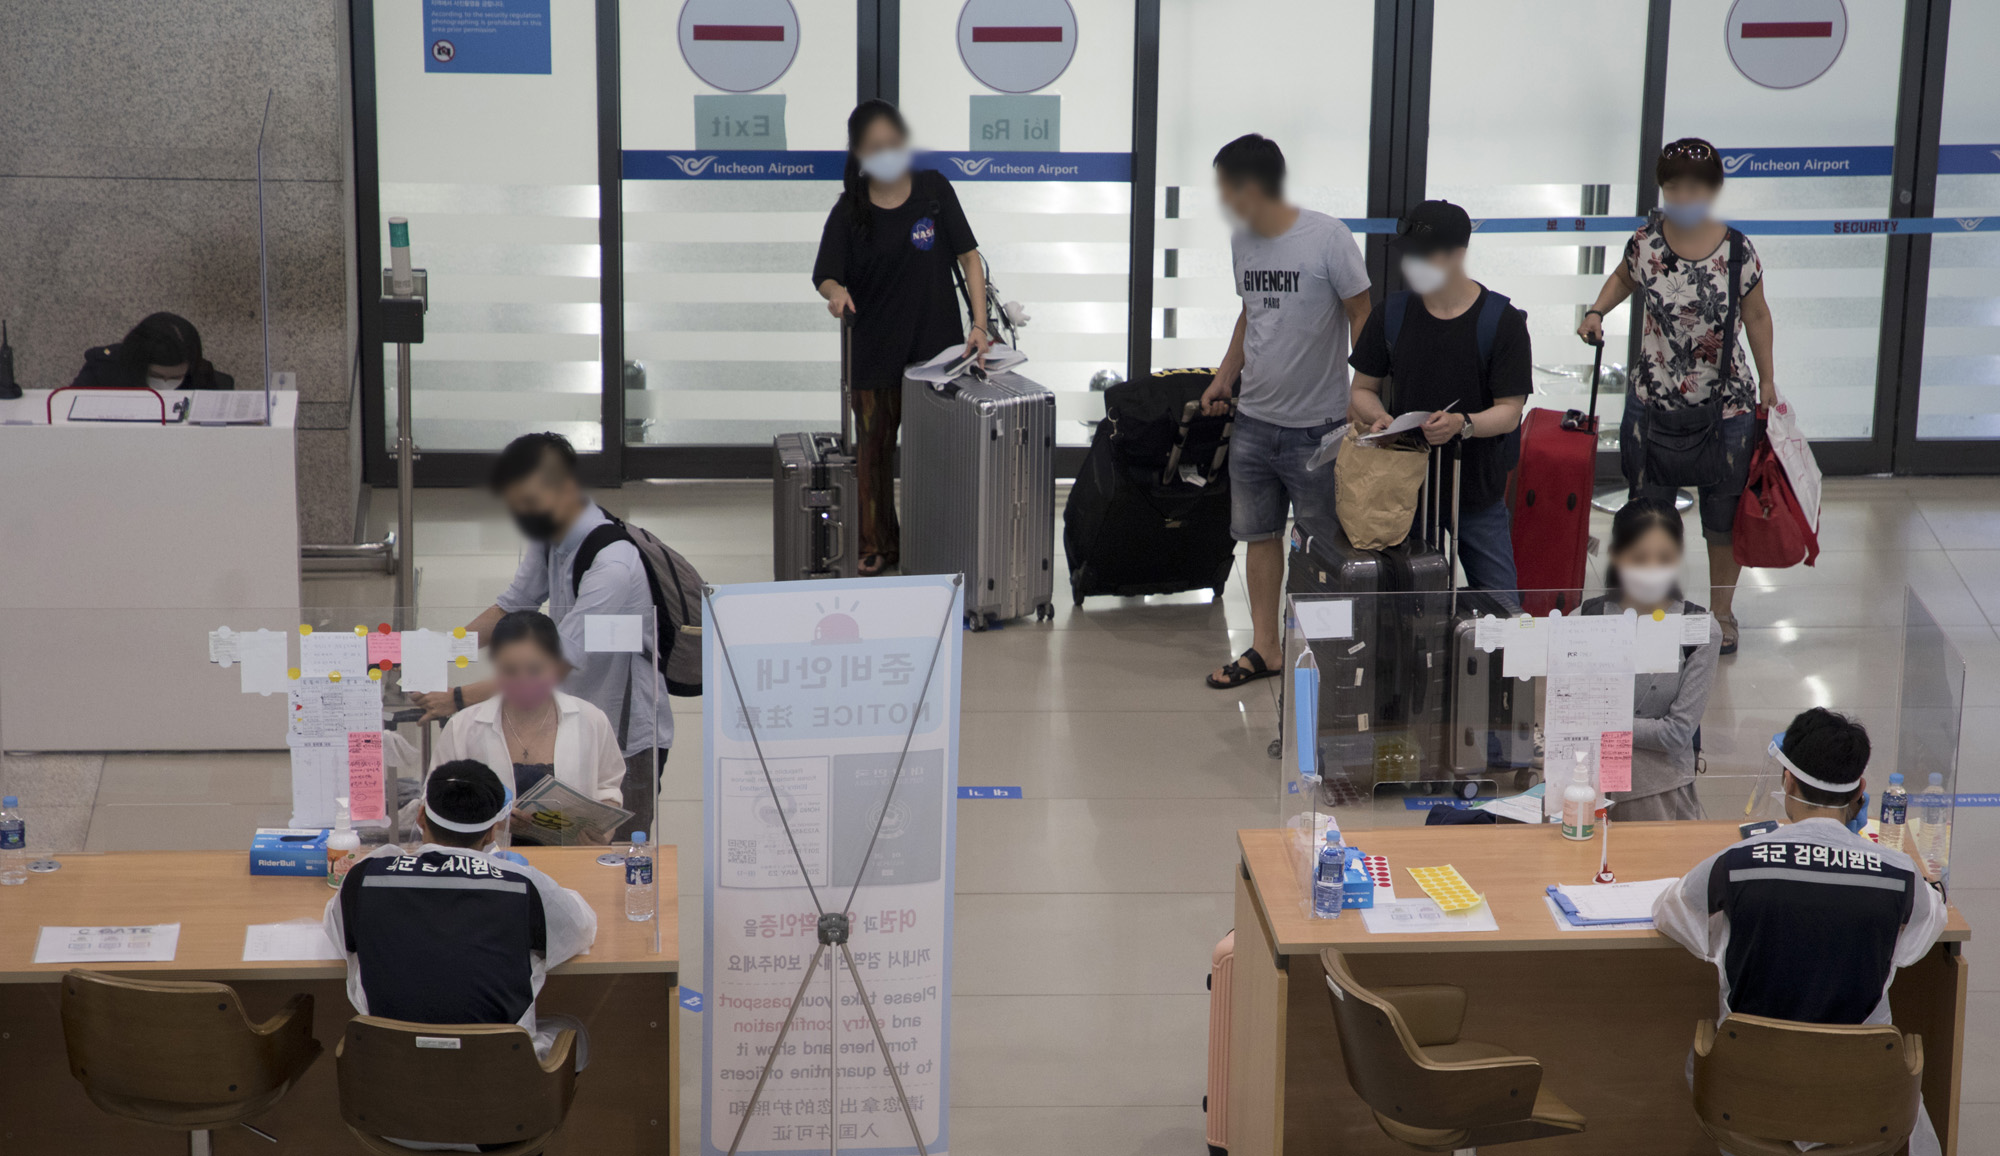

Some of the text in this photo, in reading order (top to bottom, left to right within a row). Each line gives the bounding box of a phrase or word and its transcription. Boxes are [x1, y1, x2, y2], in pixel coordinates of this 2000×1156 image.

[713, 162, 815, 176] Incheon Airport
[989, 163, 1079, 177] Incheon Airport
[1750, 159, 1850, 173] Incheon Airport
[1833, 220, 1899, 234] SECURITY
[1243, 269, 1300, 293] GIVENCHY
[1263, 297, 1280, 309] PARIS
[1416, 800, 1456, 808] Here
[257, 858, 297, 867] RiderBull
[1751, 843, 1883, 872] 국군 검역지원단
